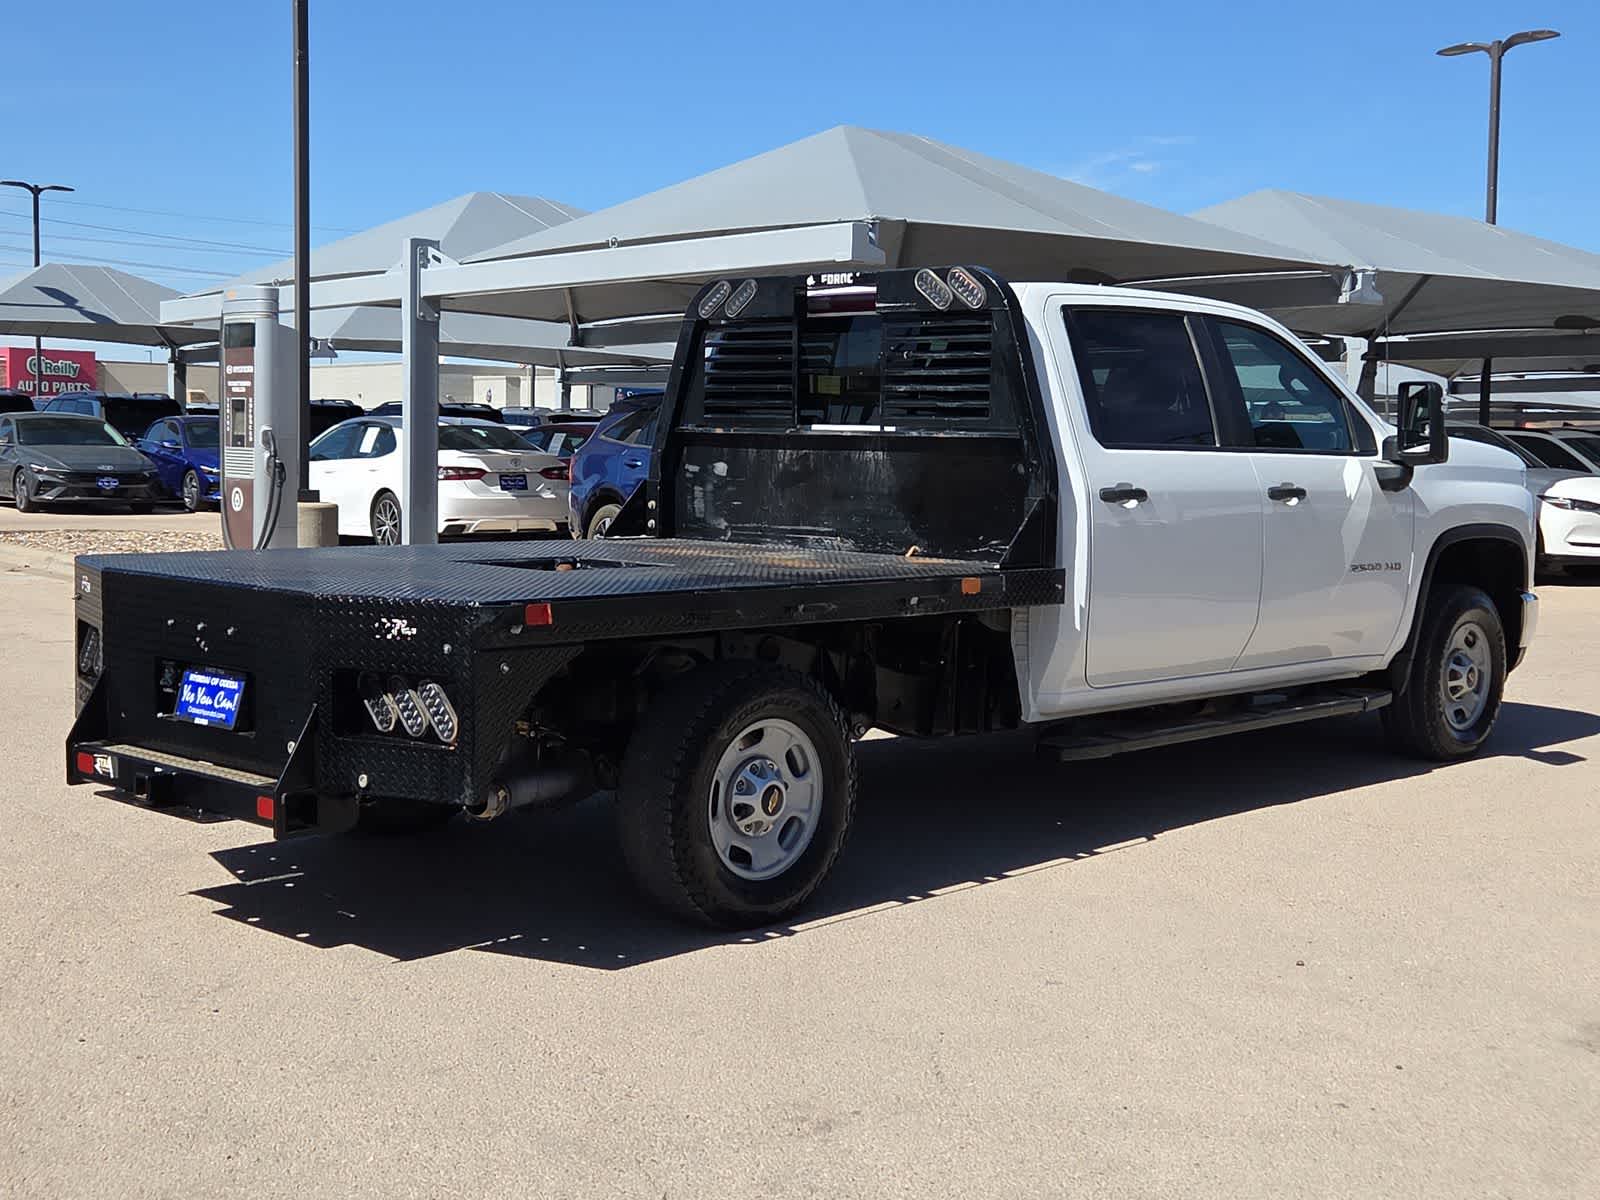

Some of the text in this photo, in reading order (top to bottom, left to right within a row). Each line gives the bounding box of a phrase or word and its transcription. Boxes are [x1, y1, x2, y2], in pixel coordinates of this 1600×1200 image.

[52, 381, 91, 393] PARTS
[1350, 562, 1382, 573] 2500
[181, 684, 195, 703] Yes
[196, 686, 213, 705] You
[213, 690, 240, 711] Can!
